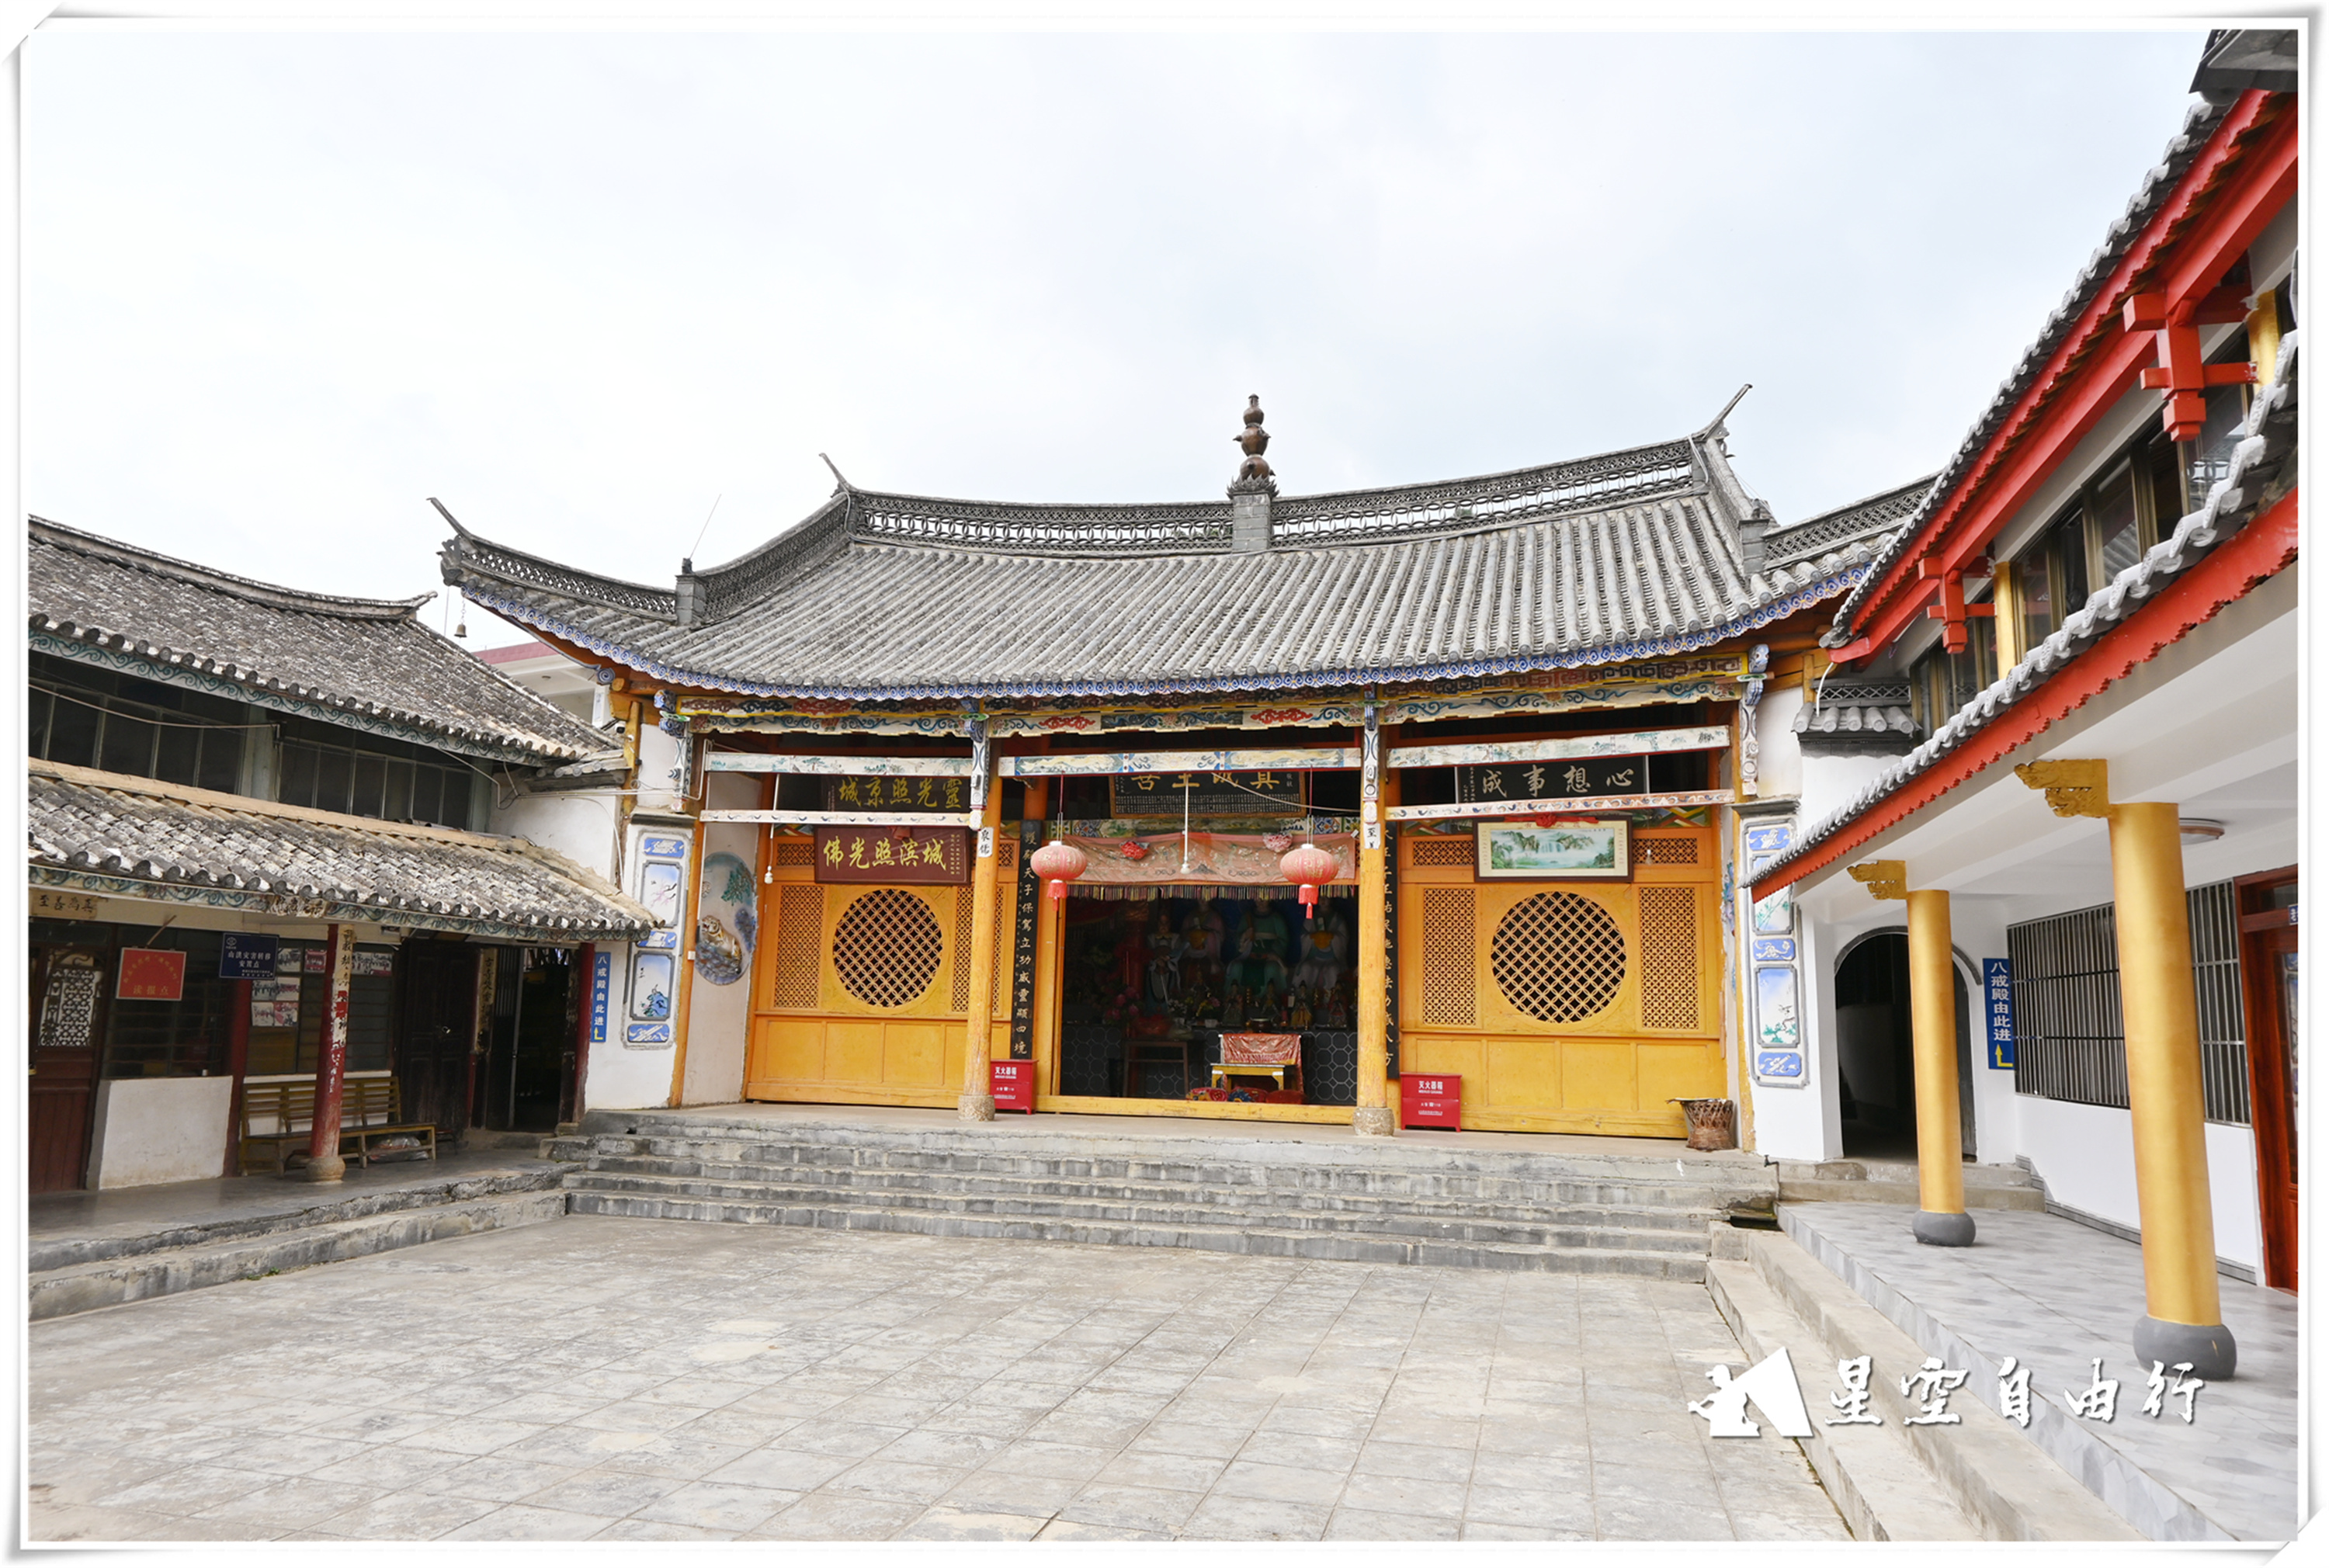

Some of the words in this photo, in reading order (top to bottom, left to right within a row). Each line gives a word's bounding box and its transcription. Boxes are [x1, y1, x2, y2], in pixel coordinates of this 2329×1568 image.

[133, 984, 168, 995] 读报点
[594, 956, 607, 1025] 八戒殿由此进
[1991, 961, 2011, 1042] 八戒殿由此进
[1418, 1081, 1443, 1090] 灭火器箱
